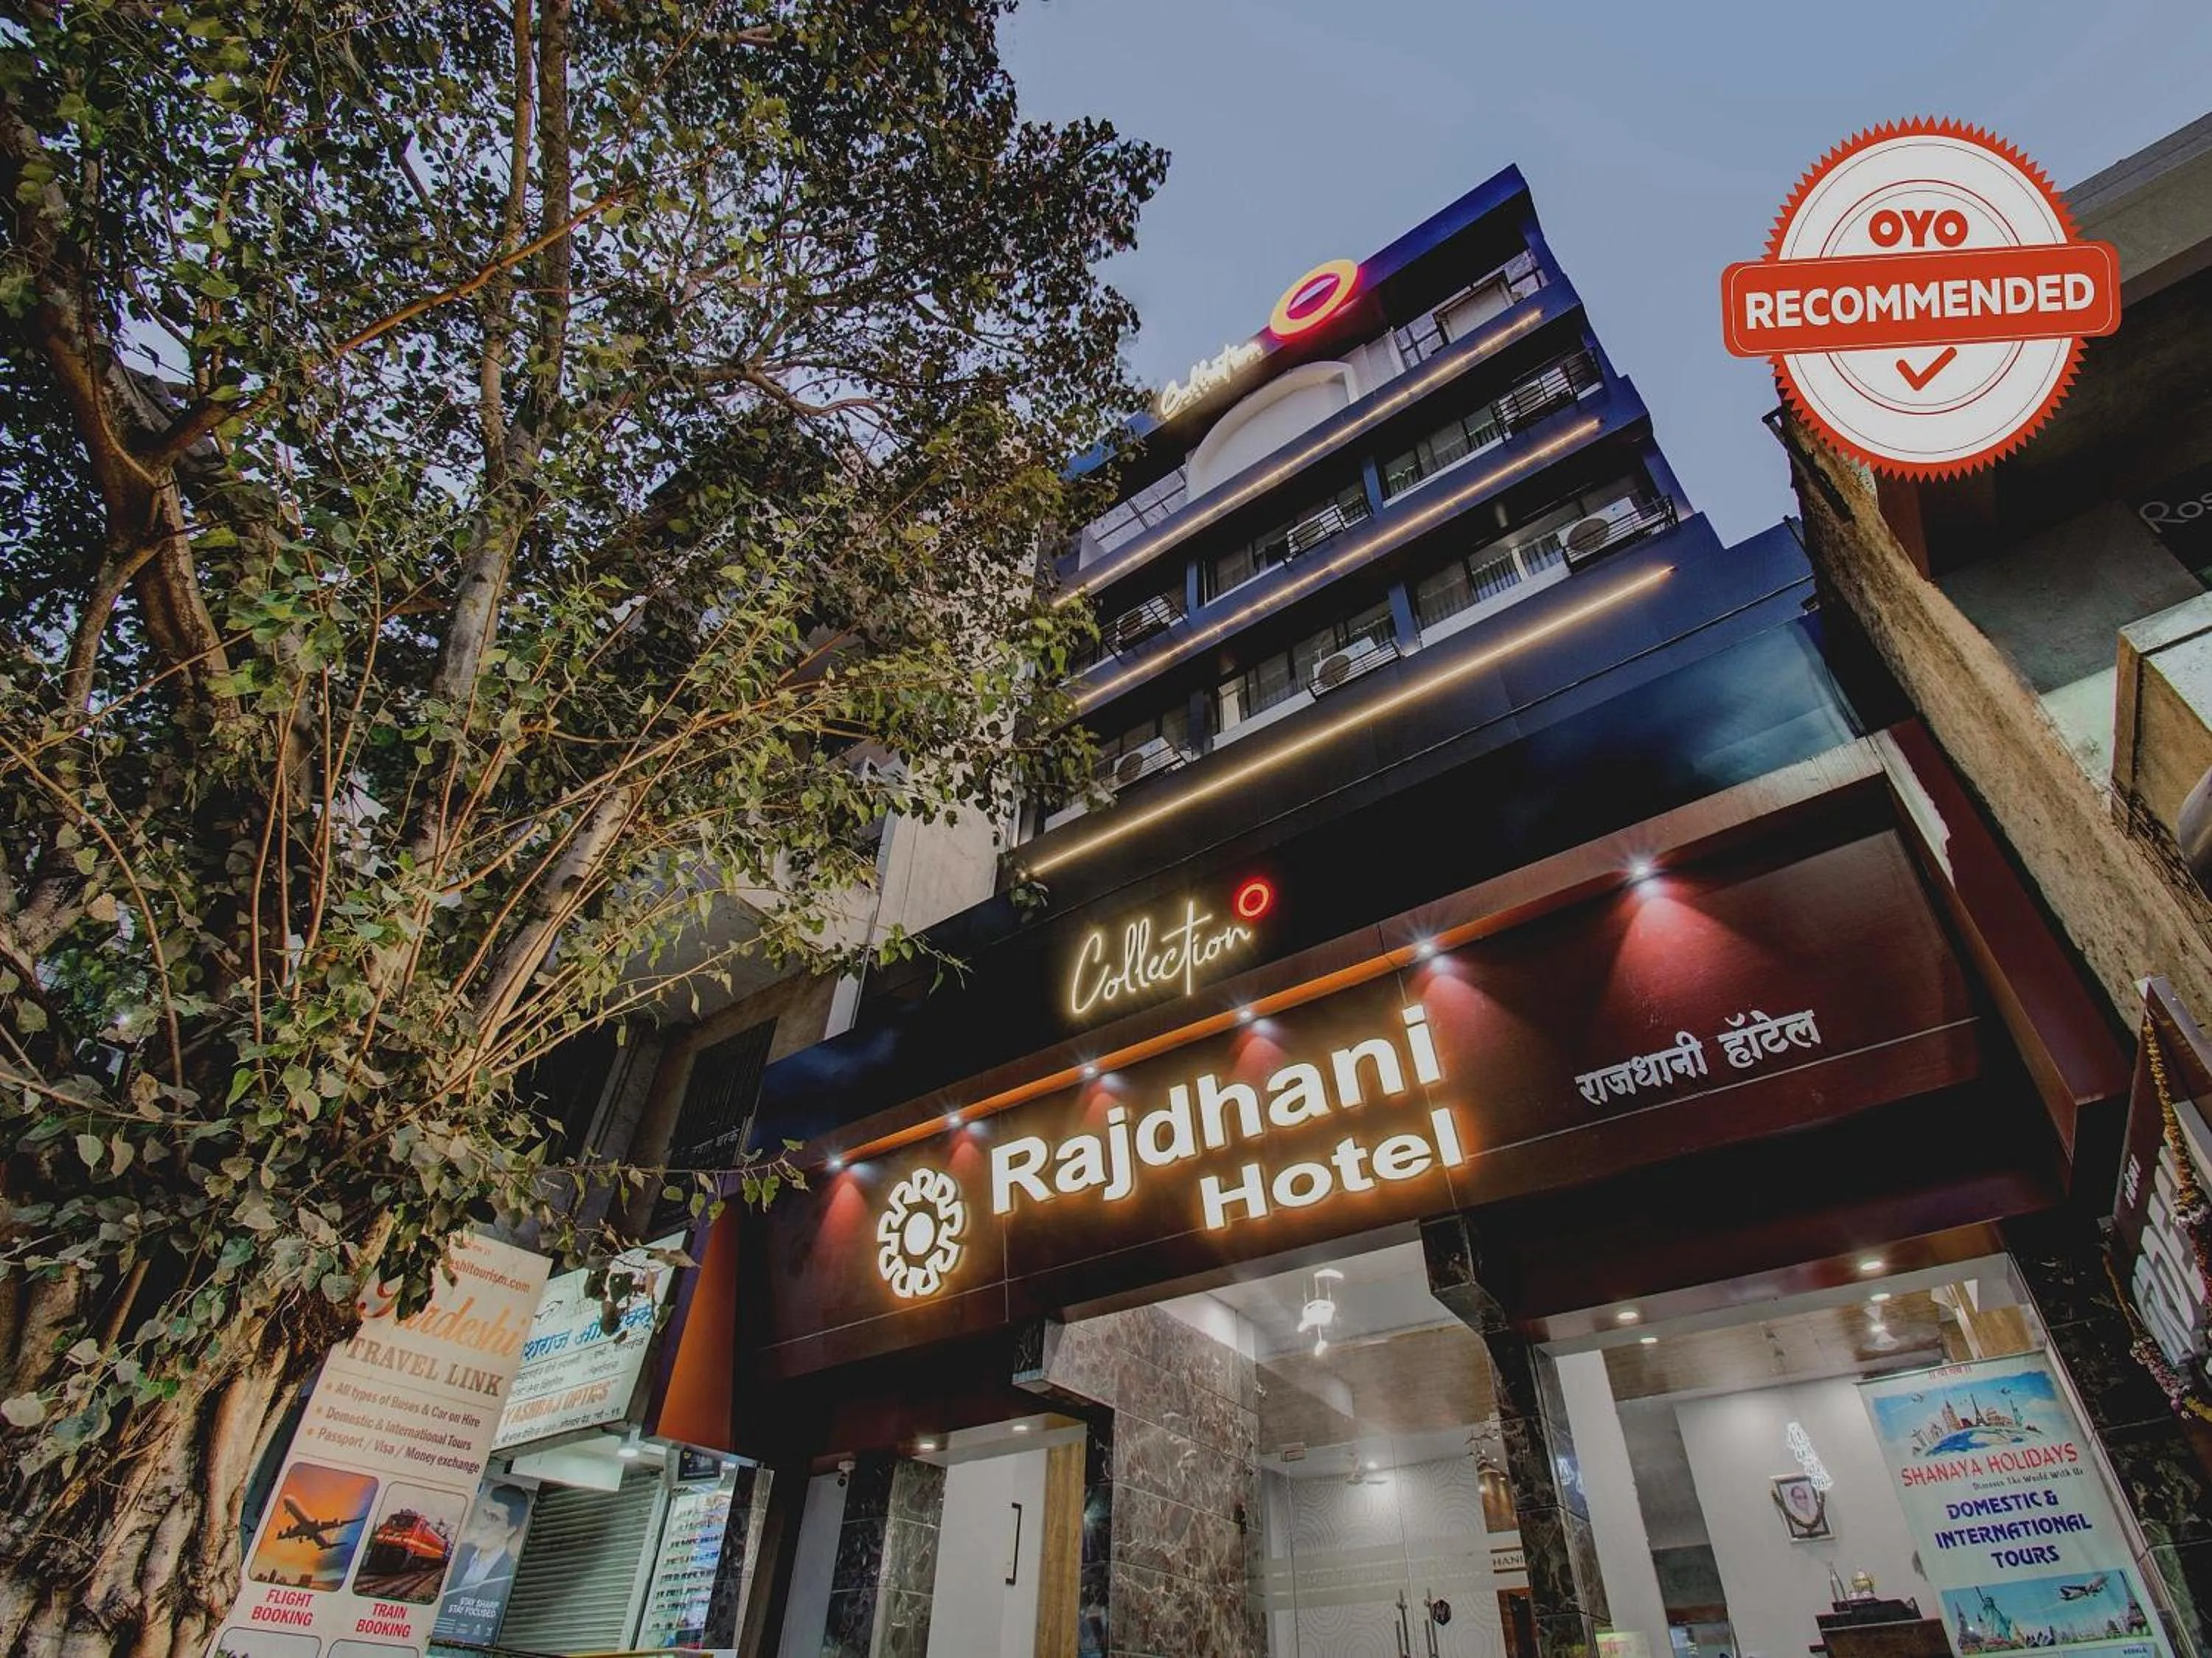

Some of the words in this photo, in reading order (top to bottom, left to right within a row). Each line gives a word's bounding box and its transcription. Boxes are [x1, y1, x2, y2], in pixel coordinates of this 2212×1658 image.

[1071, 901, 1251, 1014] Collection
[1574, 1031, 1708, 1105] राजधानी
[1717, 1009, 1821, 1069] हॉटेल
[988, 1003, 1441, 1217] Rajdhani
[1199, 1108, 1466, 1231] Hotel
[347, 1336, 439, 1381] TRAVEL
[444, 1363, 504, 1397] LINK
[335, 1382, 352, 1395] All
[352, 1387, 378, 1403] types
[379, 1392, 392, 1405] of
[421, 1404, 430, 1415] &
[431, 1406, 448, 1419] Car
[448, 1412, 460, 1423] on
[460, 1413, 481, 1428] Hire
[319, 1426, 364, 1450] Passport
[374, 1439, 395, 1455] Visa
[405, 1446, 438, 1466] Money
[437, 1455, 481, 1474] exchange
[325, 1406, 374, 1429] Domestic
[375, 1418, 385, 1430] &
[386, 1421, 448, 1446] International
[448, 1435, 473, 1451] Tours
[1901, 1459, 1983, 1488] SHANAYA
[1986, 1442, 2079, 1474] HOLIDAYS
[1946, 1491, 2042, 1520] DOMESTIC
[2043, 1488, 2059, 1506] &
[1935, 1513, 2093, 1550] INTERNATIONAL
[1991, 1545, 2060, 1569] TOURS
[251, 1606, 313, 1627] BOOKING
[266, 1588, 314, 1608] FLIGHT
[372, 1603, 408, 1620] TRAIN
[356, 1620, 411, 1638] BOOKING
